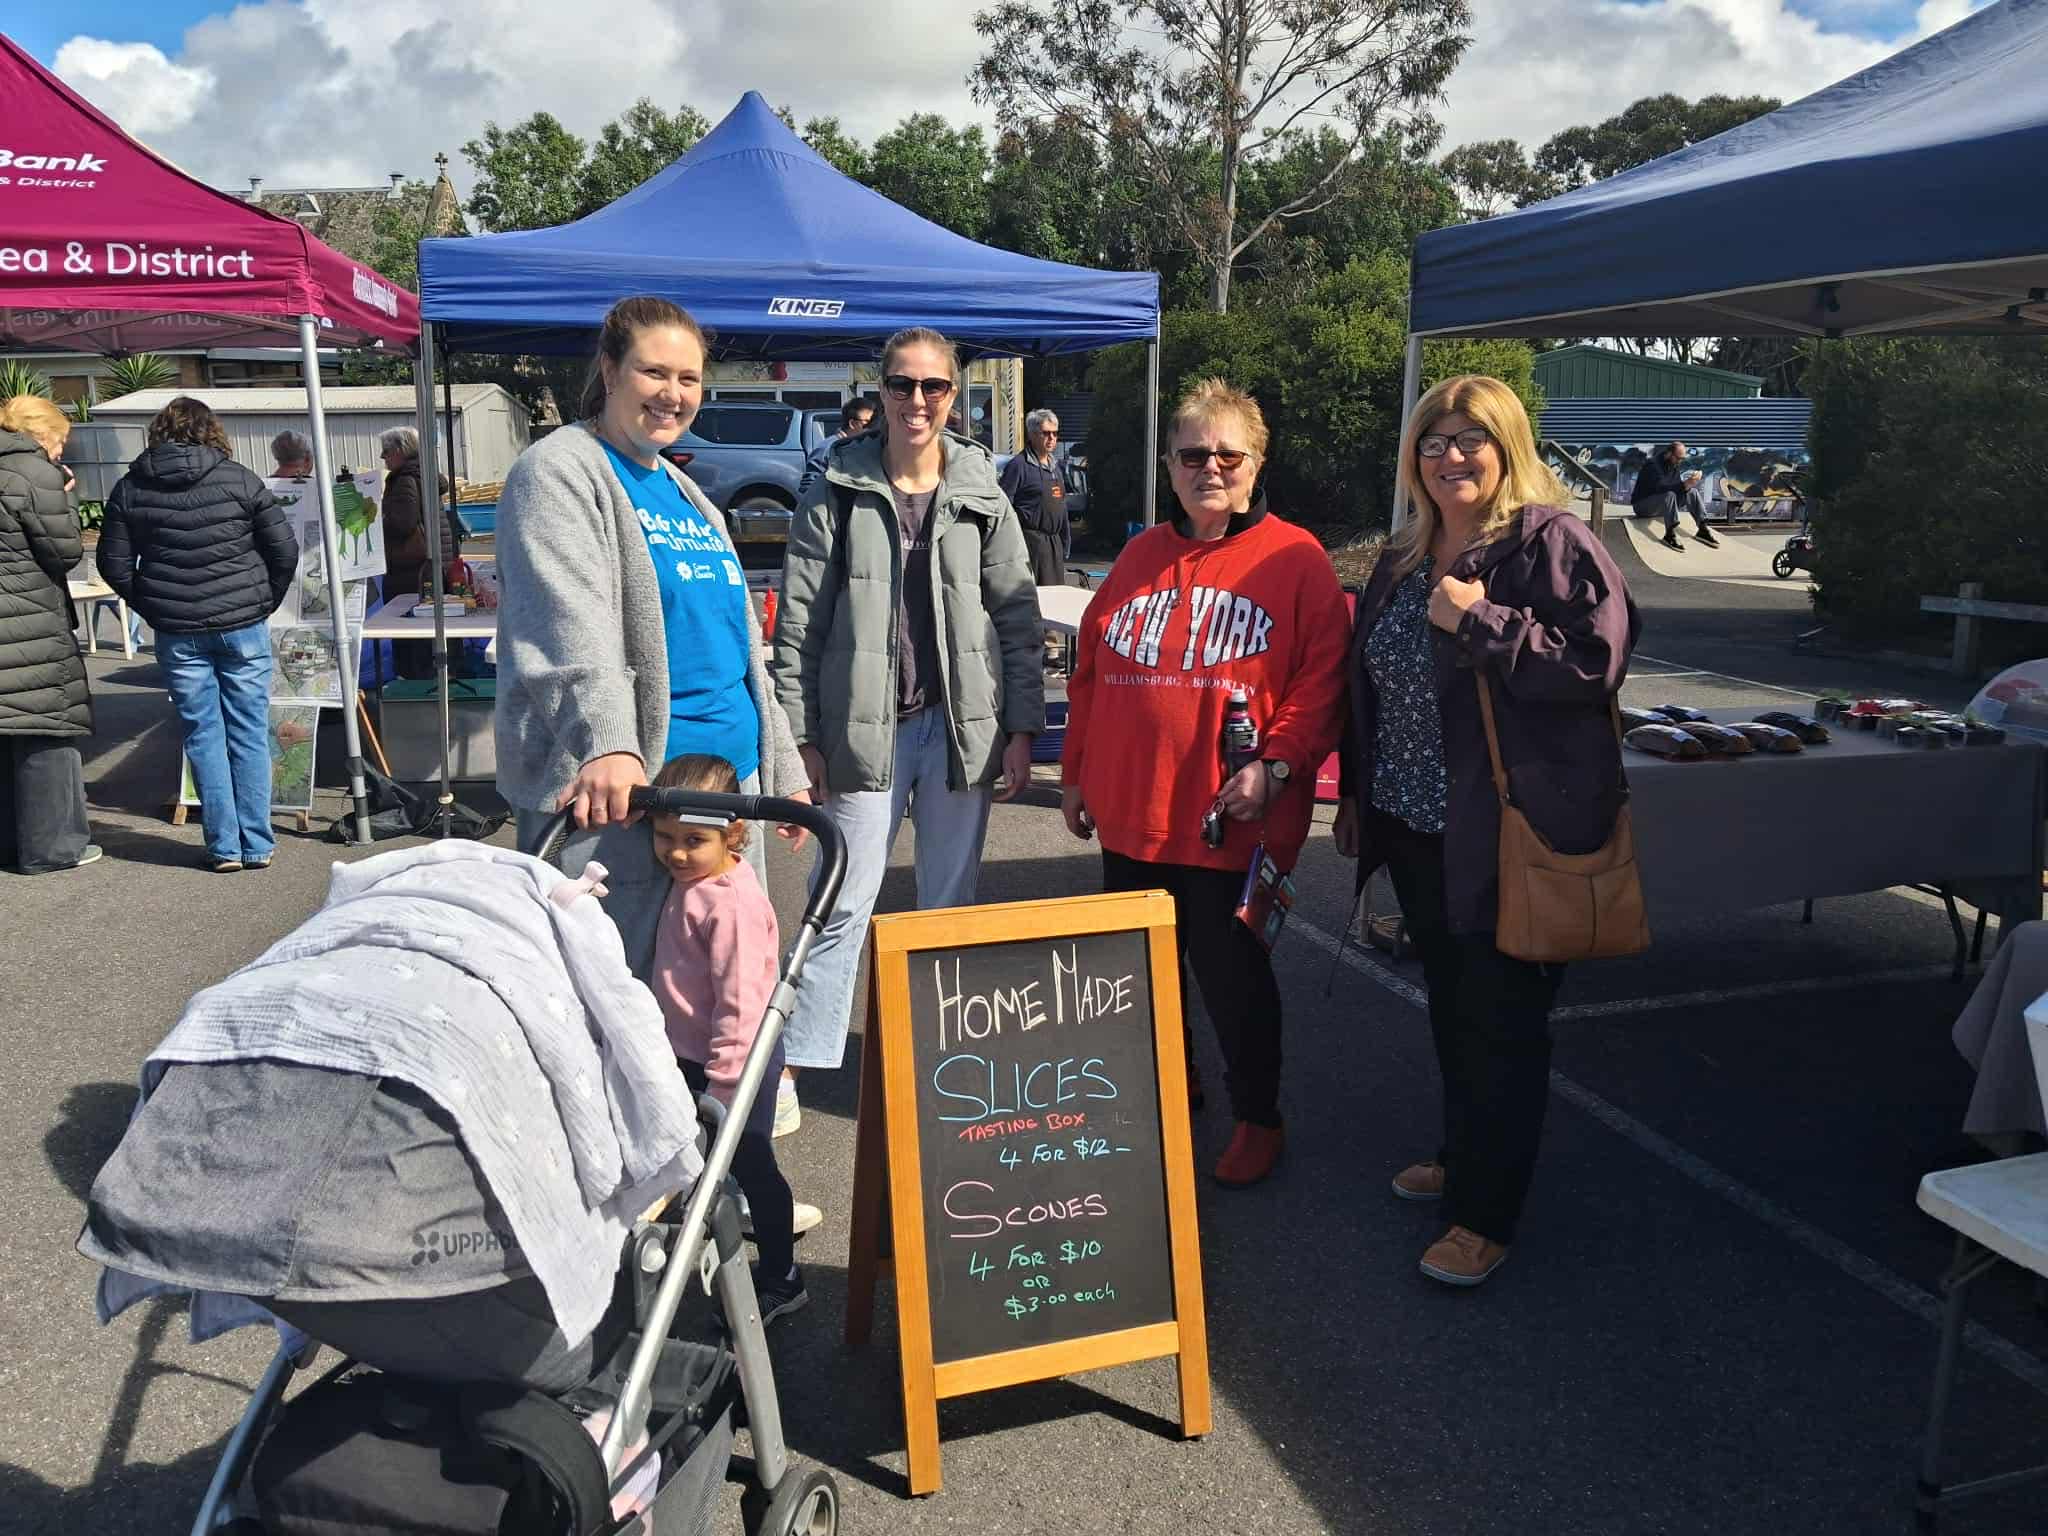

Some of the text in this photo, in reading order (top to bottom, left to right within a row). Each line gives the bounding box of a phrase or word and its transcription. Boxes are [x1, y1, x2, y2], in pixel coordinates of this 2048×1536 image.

[17, 177, 96, 188] District
[63, 241, 94, 273] &
[106, 243, 255, 278] District
[769, 298, 844, 317] KINGS
[1103, 585, 1274, 671] NEW YORK
[1104, 672, 1256, 697] WILLIAMSBURG BROOKLYN
[935, 943, 1133, 1051] HOME MADE
[934, 1054, 1118, 1121] SLICES
[958, 1112, 1086, 1142] TASTING BOX
[999, 1147, 1022, 1172] 4
[943, 1180, 1108, 1238] SCONES
[969, 1251, 995, 1281] 4
[1060, 1240, 1102, 1265] $10
[1074, 1282, 1115, 1302] each
